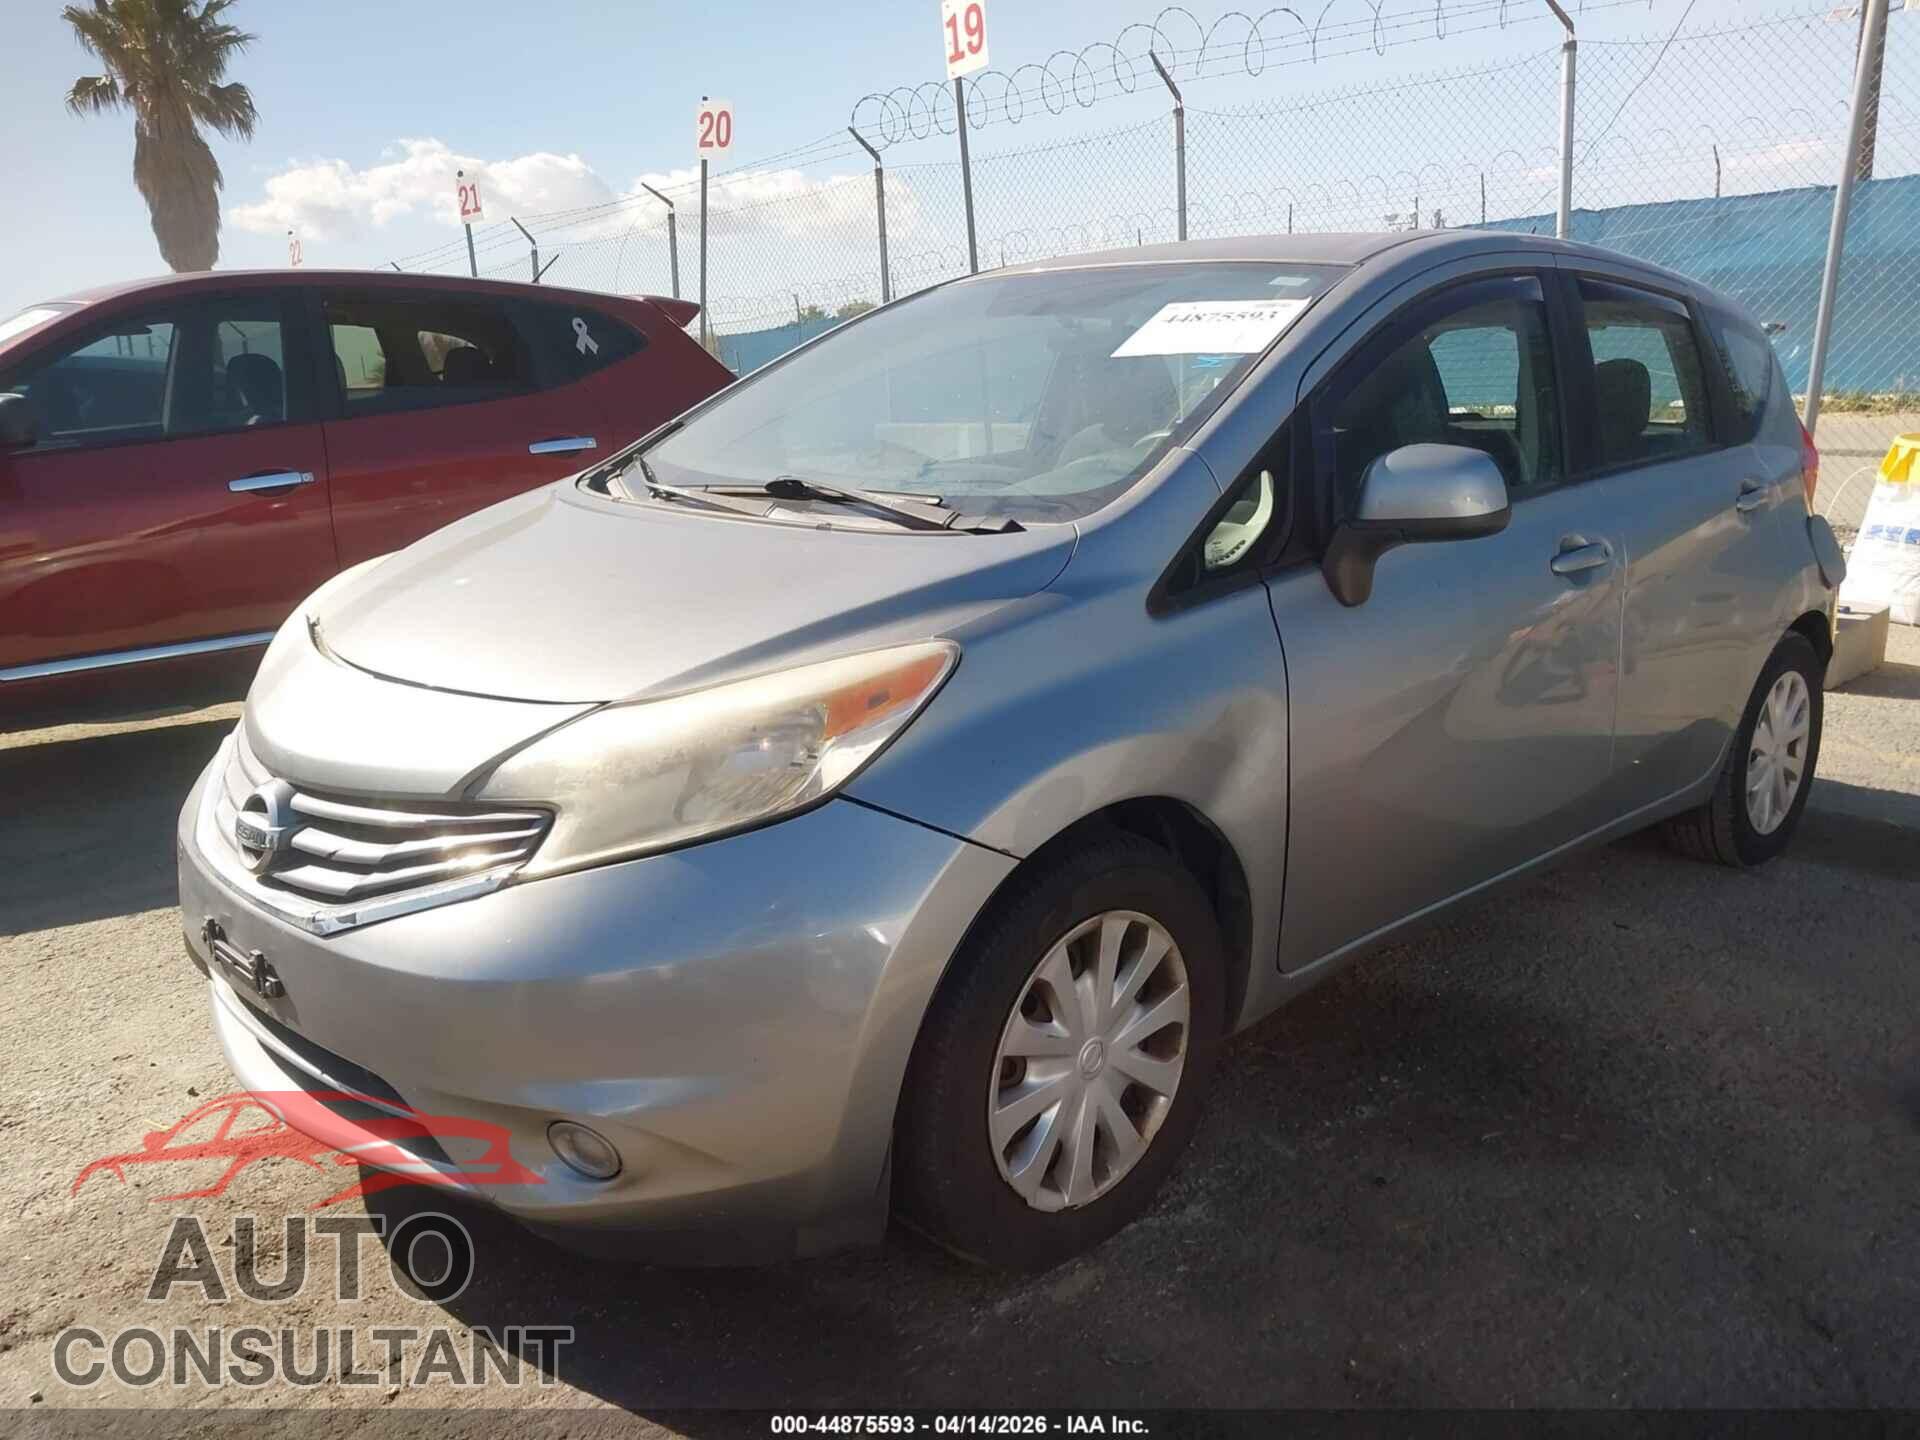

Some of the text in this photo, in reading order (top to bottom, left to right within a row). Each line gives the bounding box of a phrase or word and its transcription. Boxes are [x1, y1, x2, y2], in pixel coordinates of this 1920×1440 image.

[945, 2, 984, 64] 19
[699, 110, 731, 148] 20
[458, 183, 482, 216] 21
[289, 240, 303, 267] 22
